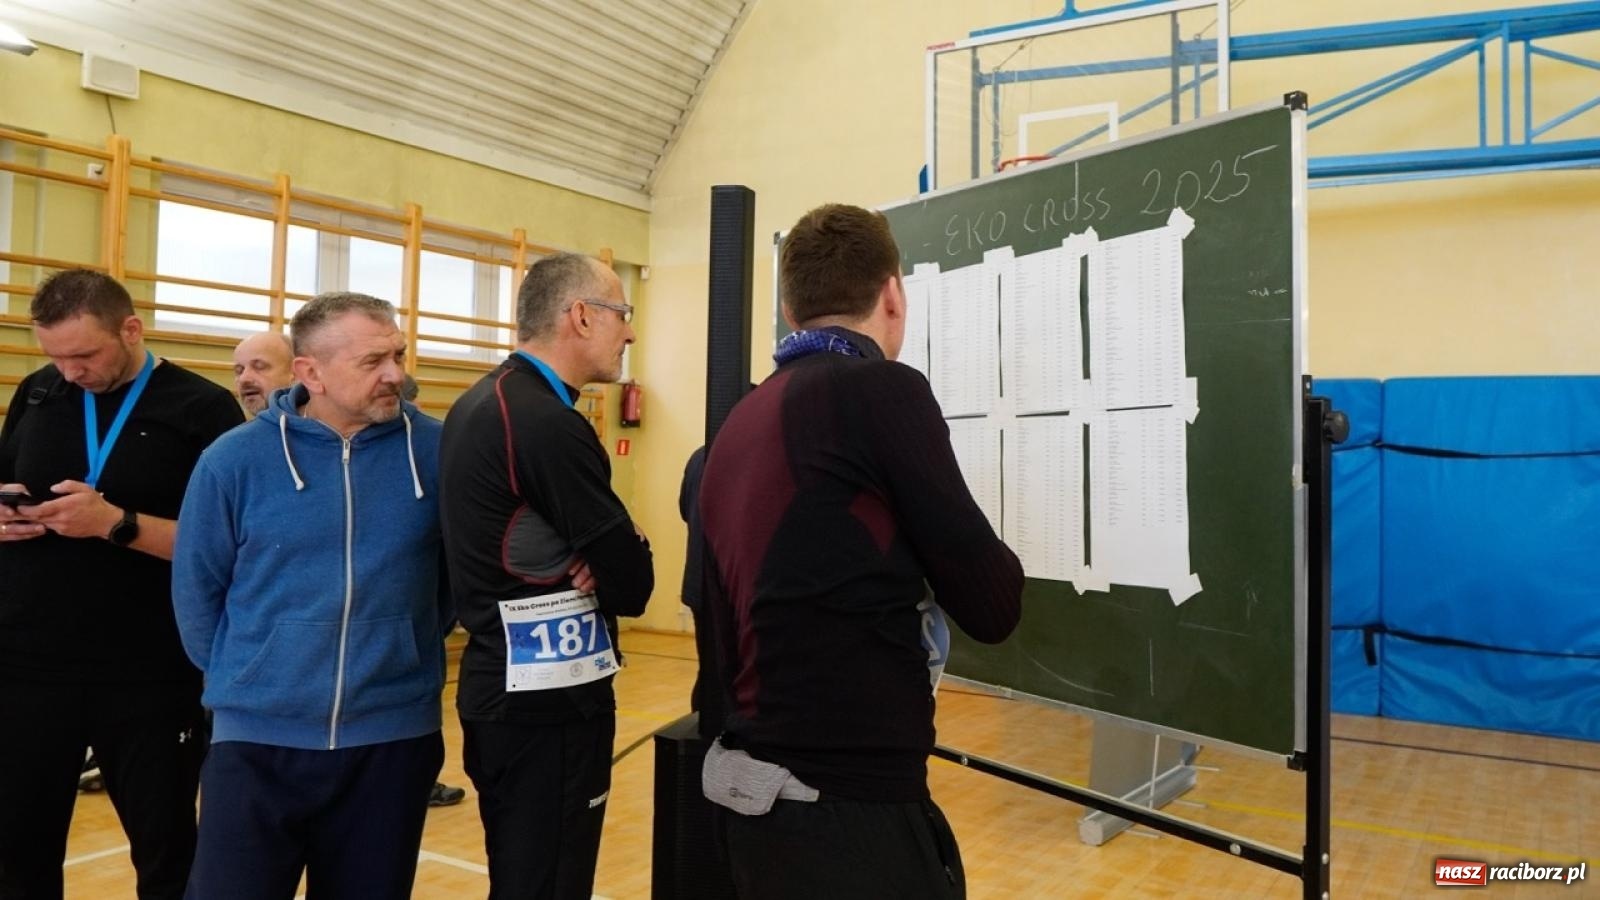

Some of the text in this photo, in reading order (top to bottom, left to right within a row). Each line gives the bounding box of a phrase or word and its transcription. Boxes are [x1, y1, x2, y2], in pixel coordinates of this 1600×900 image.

[945, 210, 1007, 256] EKO
[1140, 144, 1279, 216] 2025
[530, 602, 550, 610] Cross
[529, 612, 596, 659] 187
